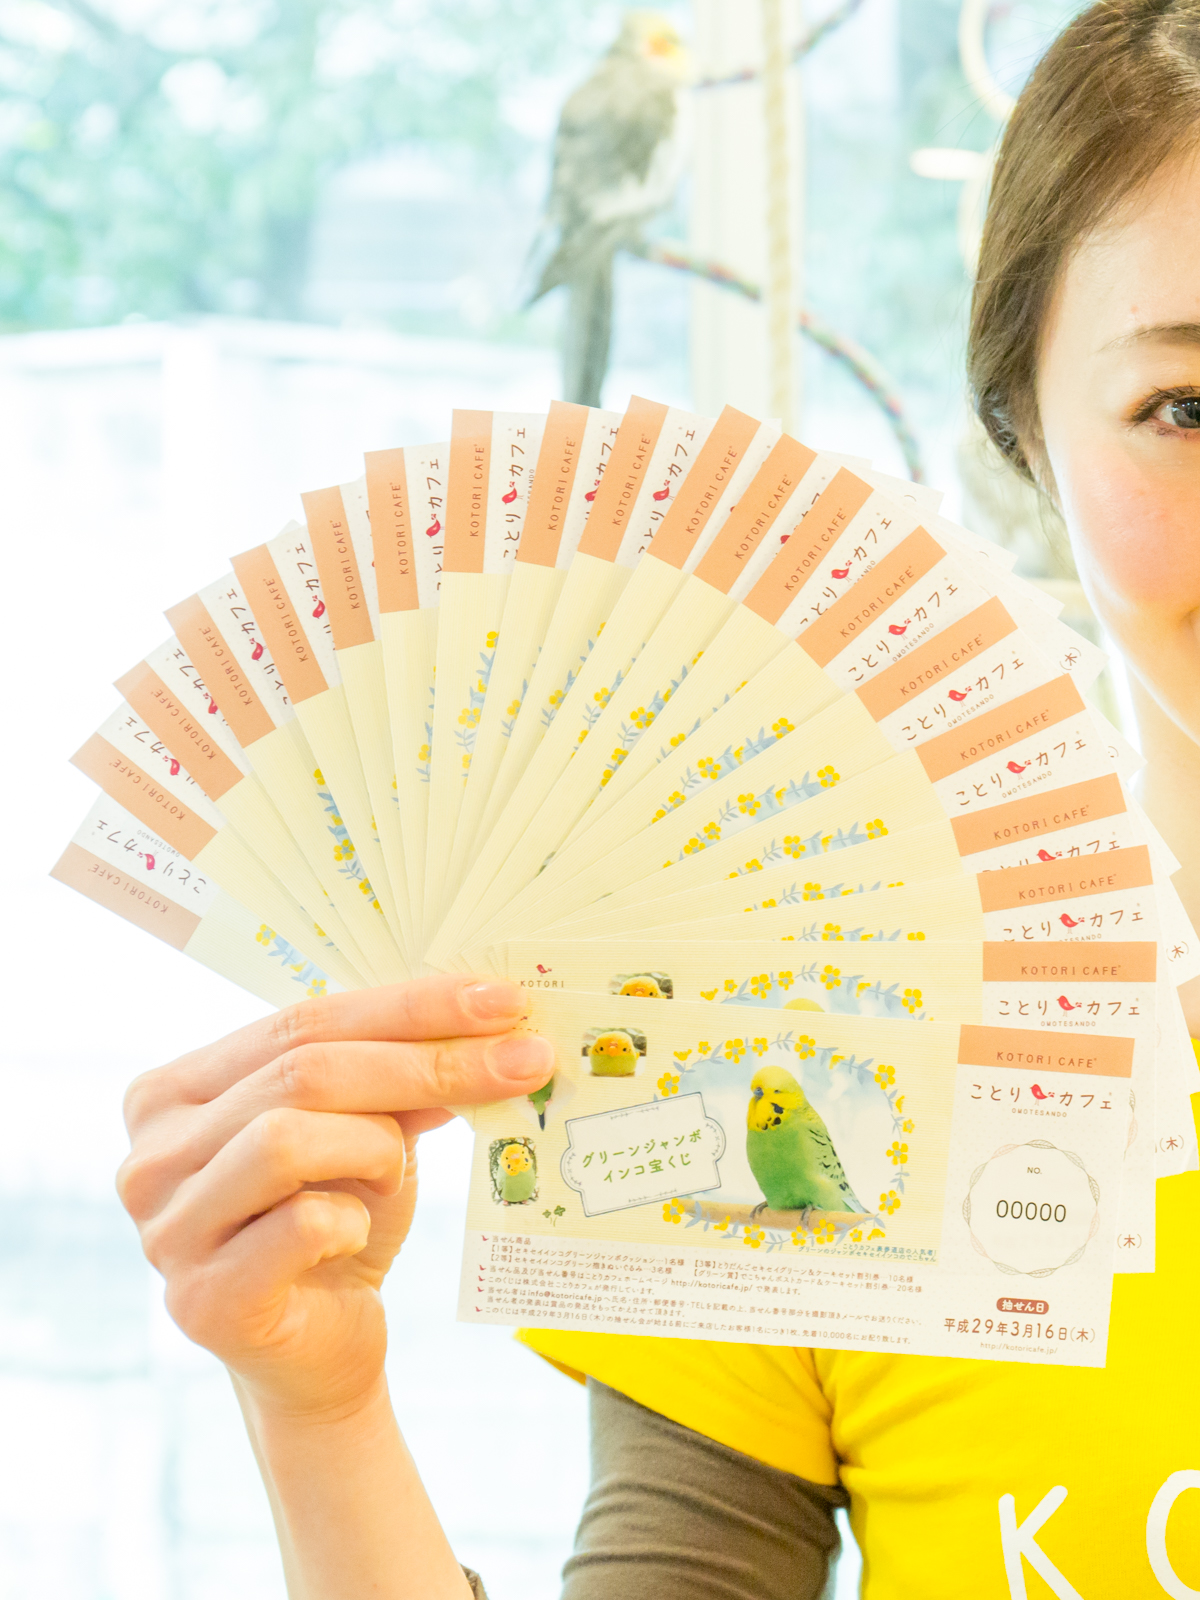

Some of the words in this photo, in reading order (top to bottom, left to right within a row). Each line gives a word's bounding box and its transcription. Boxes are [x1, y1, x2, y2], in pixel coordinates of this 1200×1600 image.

[474, 447, 484, 480] CAFE
[548, 479, 567, 531] KOTORI
[561, 440, 576, 474] CAFE
[612, 475, 637, 526] KOTORI
[633, 438, 651, 470] CAFE
[686, 485, 717, 534] KOTORI
[716, 449, 738, 482] CAFE
[392, 484, 404, 518] CAFE
[469, 486, 482, 537] KOTORI
[735, 512, 770, 560] KOTORI
[768, 476, 792, 510] CAFE
[332, 521, 348, 554] CAFE
[395, 524, 409, 575] KOTORI
[784, 545, 822, 591] KOTORI
[821, 510, 847, 542] CAFE
[265, 578, 285, 610] CAFE
[341, 559, 360, 610] KOTORI
[839, 597, 884, 638] KOTORI
[885, 569, 914, 597] CAFE
[202, 626, 224, 657] CAFE
[282, 614, 309, 662] KOTORI
[221, 660, 253, 706] KOTORI
[900, 659, 949, 696] KOTORI
[951, 636, 984, 662] CAFE
[153, 689, 180, 717] CAFE
[178, 718, 217, 760] KOTORI
[959, 730, 1012, 761] KOTORI
[1015, 711, 1050, 734] CAFE
[112, 759, 142, 784] CAFE
[142, 783, 186, 821] KOTORI
[993, 818, 1048, 841] KOTORI
[1053, 807, 1088, 824] CAFE
[93, 864, 121, 886] CAFE
[1018, 882, 1073, 900] KOTORI
[1079, 876, 1115, 890] CAFE
[123, 882, 169, 914] KOTORI
[520, 980, 564, 988] KOTORI
[1021, 966, 1076, 976] KOTORI
[1082, 966, 1118, 976] CAFE
[997, 1052, 1051, 1065] KOTORI
[1058, 1057, 1094, 1069] CAFE
[583, 1129, 702, 1168] グリーンジャンボ
[603, 1153, 691, 1183] インコ宝くじ
[1027, 1166, 1042, 1175] NO.
[996, 1199, 1067, 1223] 00000
[1001, 1298, 1046, 1314] 抽せん日
